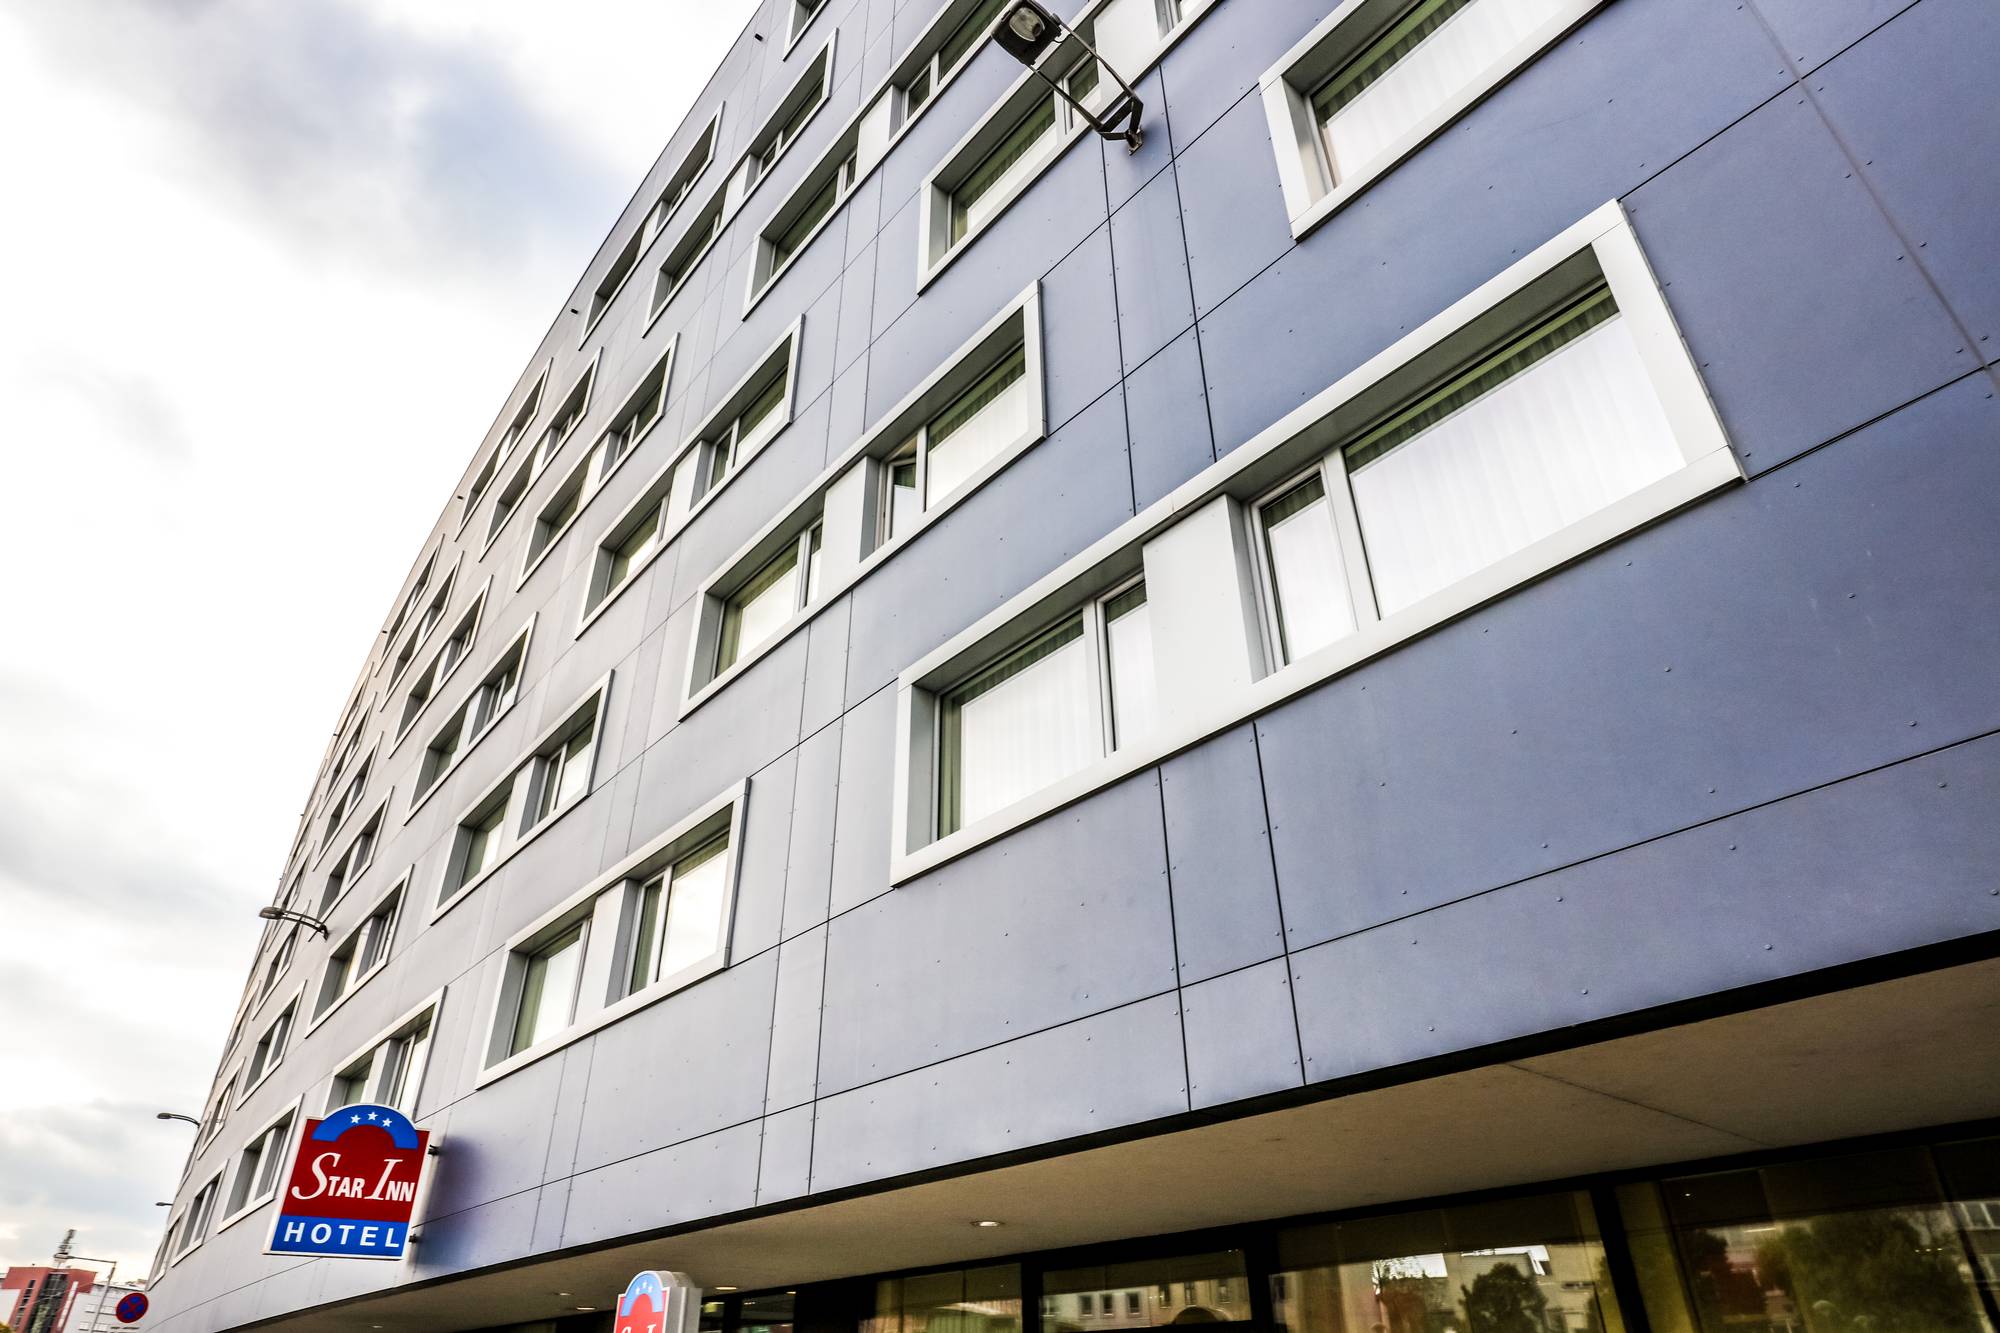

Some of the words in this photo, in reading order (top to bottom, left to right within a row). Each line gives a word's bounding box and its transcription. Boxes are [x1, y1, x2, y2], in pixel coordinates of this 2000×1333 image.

[291, 1151, 366, 1200] STAR
[363, 1158, 415, 1202] INN
[283, 1221, 400, 1248] HOTEL
